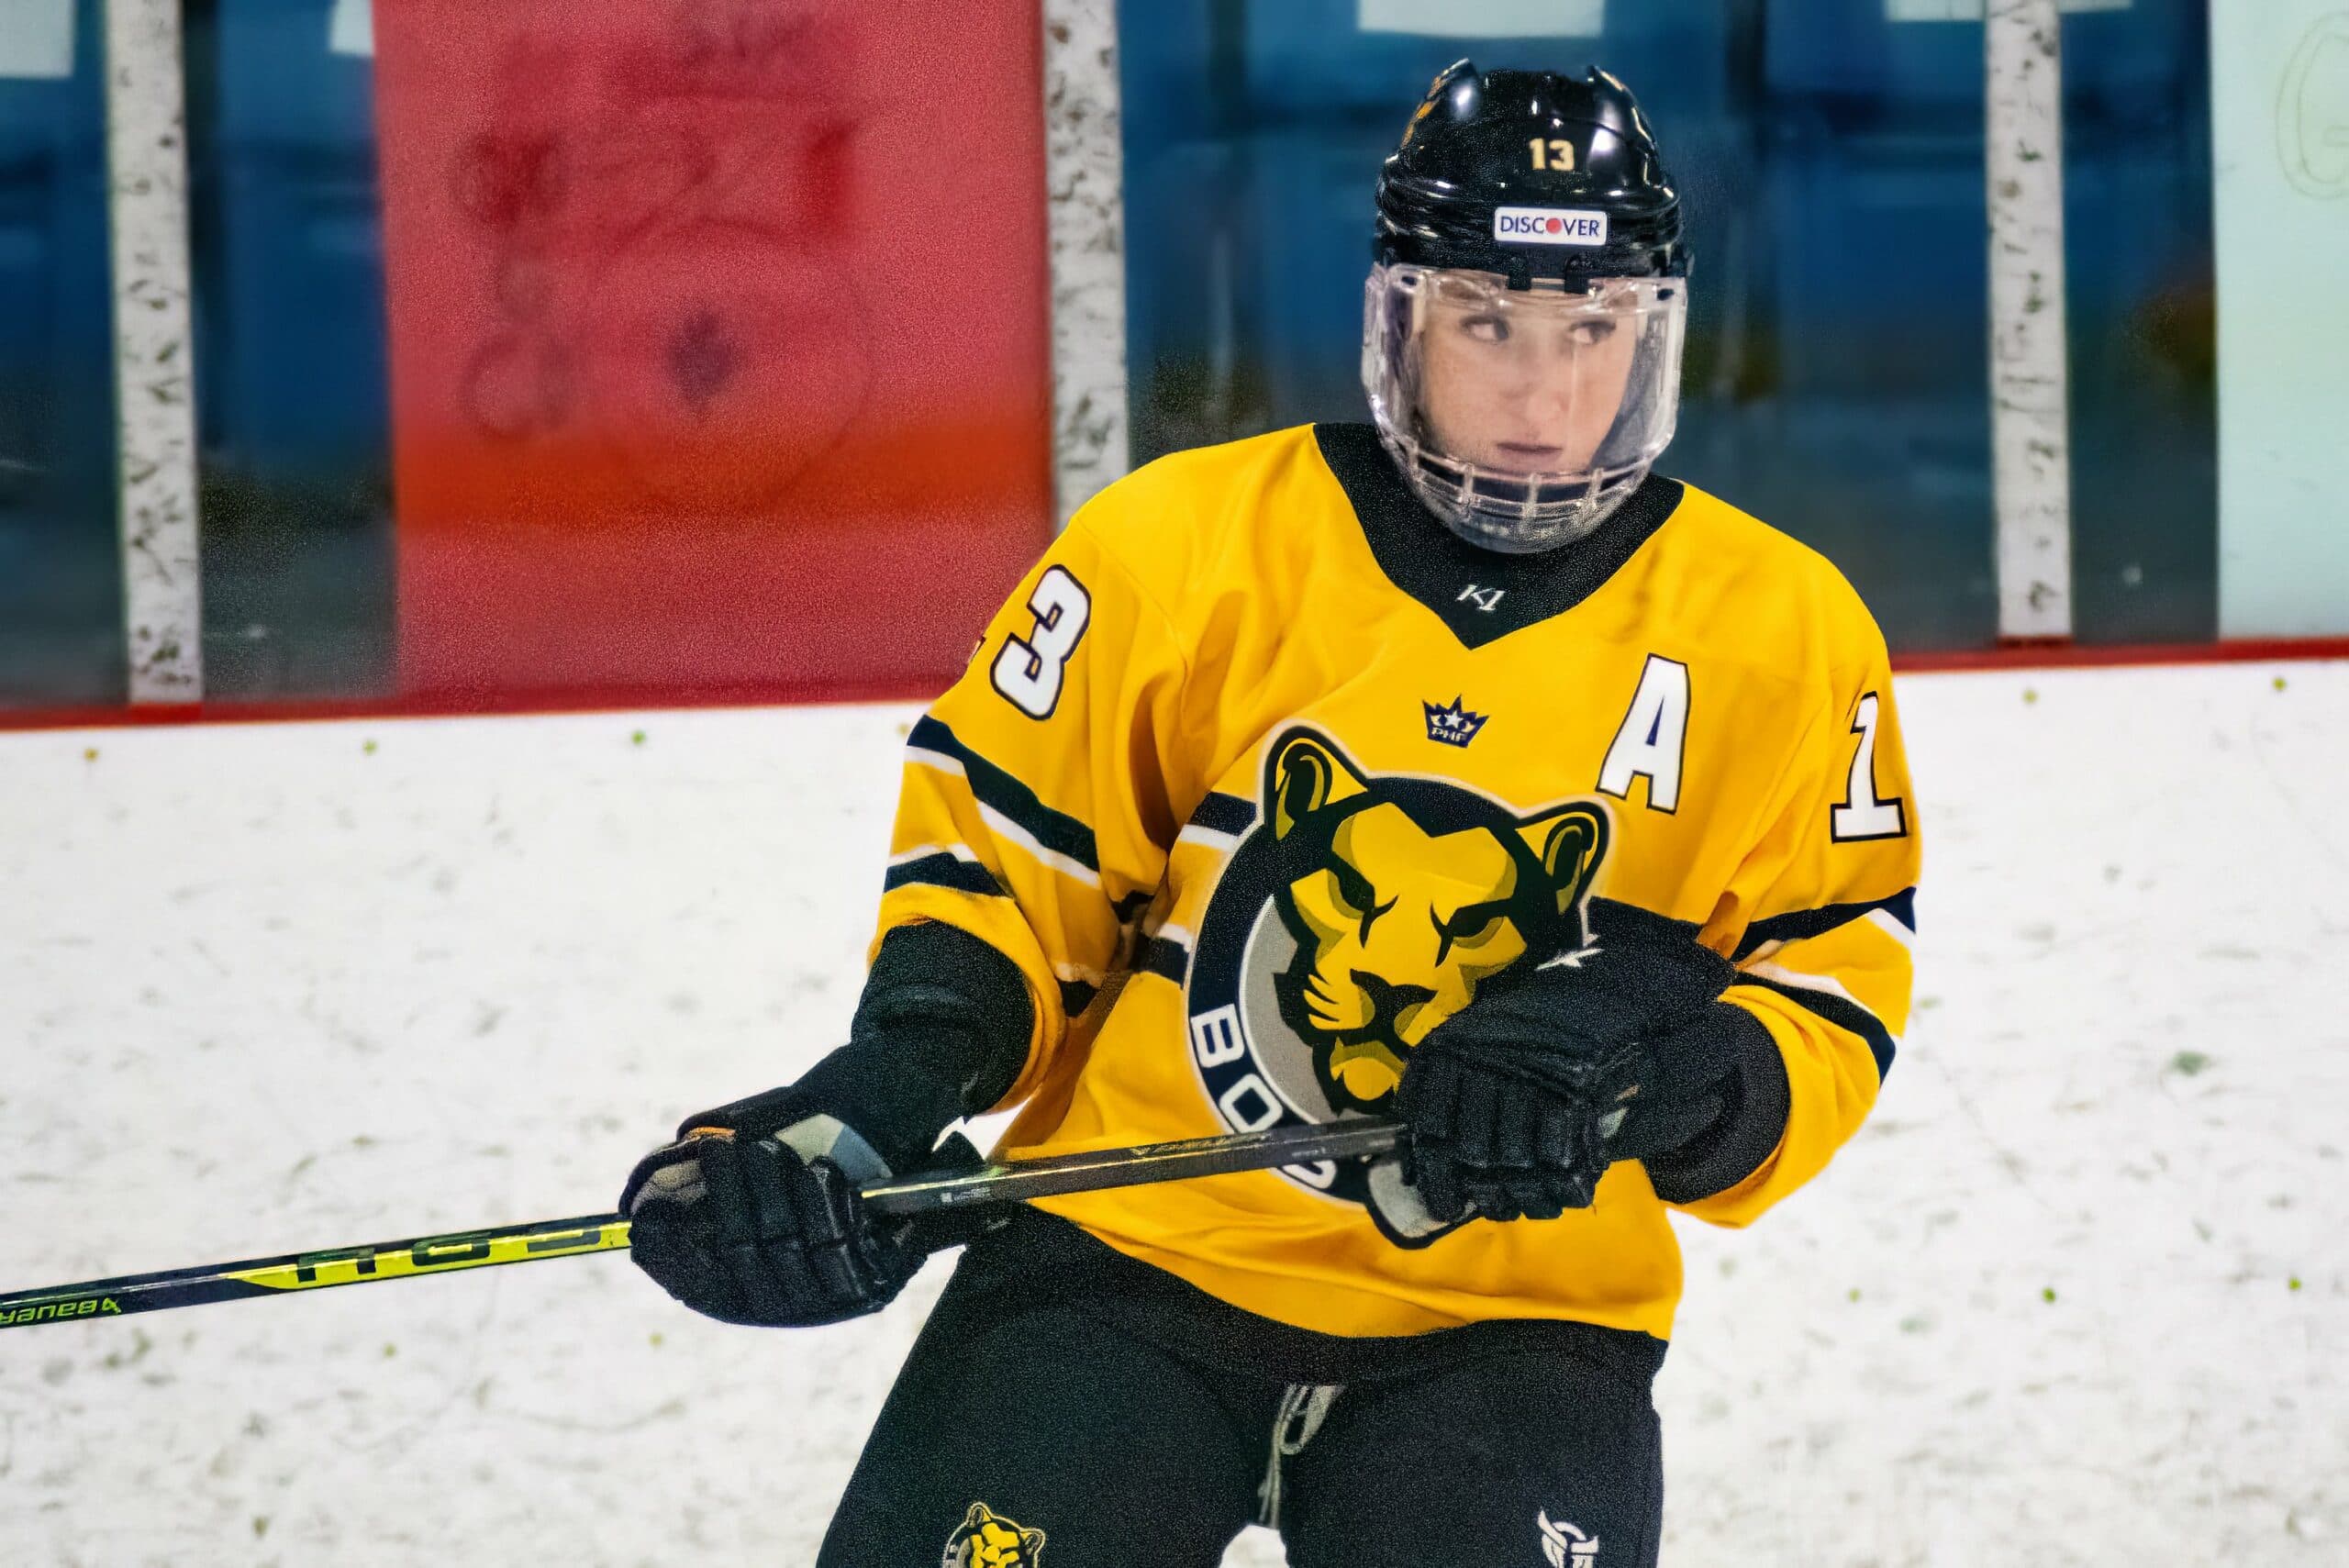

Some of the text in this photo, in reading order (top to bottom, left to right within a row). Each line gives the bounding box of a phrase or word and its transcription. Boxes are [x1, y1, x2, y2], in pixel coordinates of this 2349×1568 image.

[1529, 138, 1575, 171] 13
[1500, 216, 1600, 237] DISCOVER
[1595, 652, 1691, 815] A
[1830, 691, 1908, 843] 1
